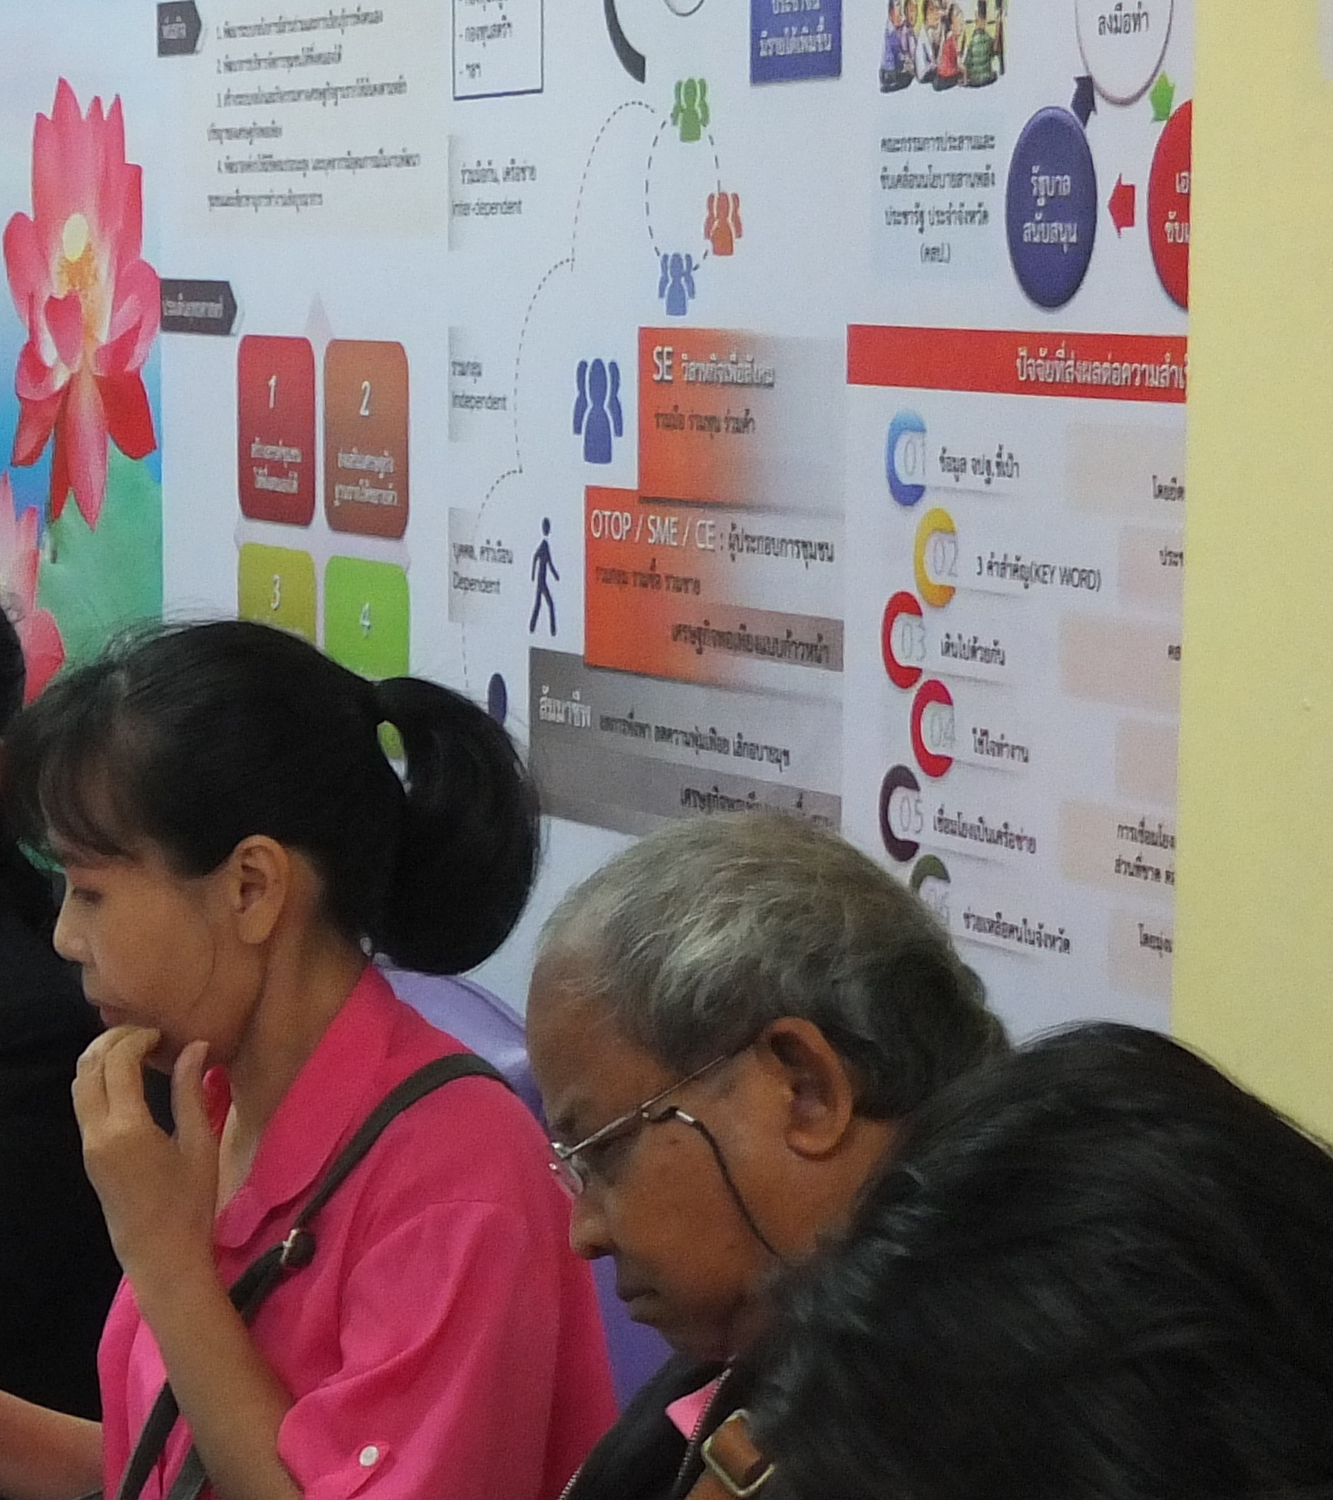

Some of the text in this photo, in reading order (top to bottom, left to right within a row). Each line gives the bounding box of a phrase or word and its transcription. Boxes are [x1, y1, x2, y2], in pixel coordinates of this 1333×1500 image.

[1097, 1, 1149, 36] ลงมือทำ
[1030, 165, 1071, 206] รัฐบาล
[1022, 216, 1079, 254] สนับสนุน
[652, 346, 674, 382] SE
[1016, 341, 1187, 390] ปัจจัยที่ส่งผลต่อความสำเ
[267, 375, 279, 409] 1
[358, 381, 371, 417] 2
[590, 508, 632, 542] OTOP
[646, 514, 679, 548] SME
[695, 519, 716, 552] CE
[728, 522, 835, 570] ผู้ประกอบการชุมชน
[933, 539, 959, 578] 02
[270, 574, 282, 610] 3
[1058, 565, 1102, 592] WORD)
[358, 603, 372, 638] 4
[900, 620, 927, 662] 03
[899, 794, 924, 835] 05
